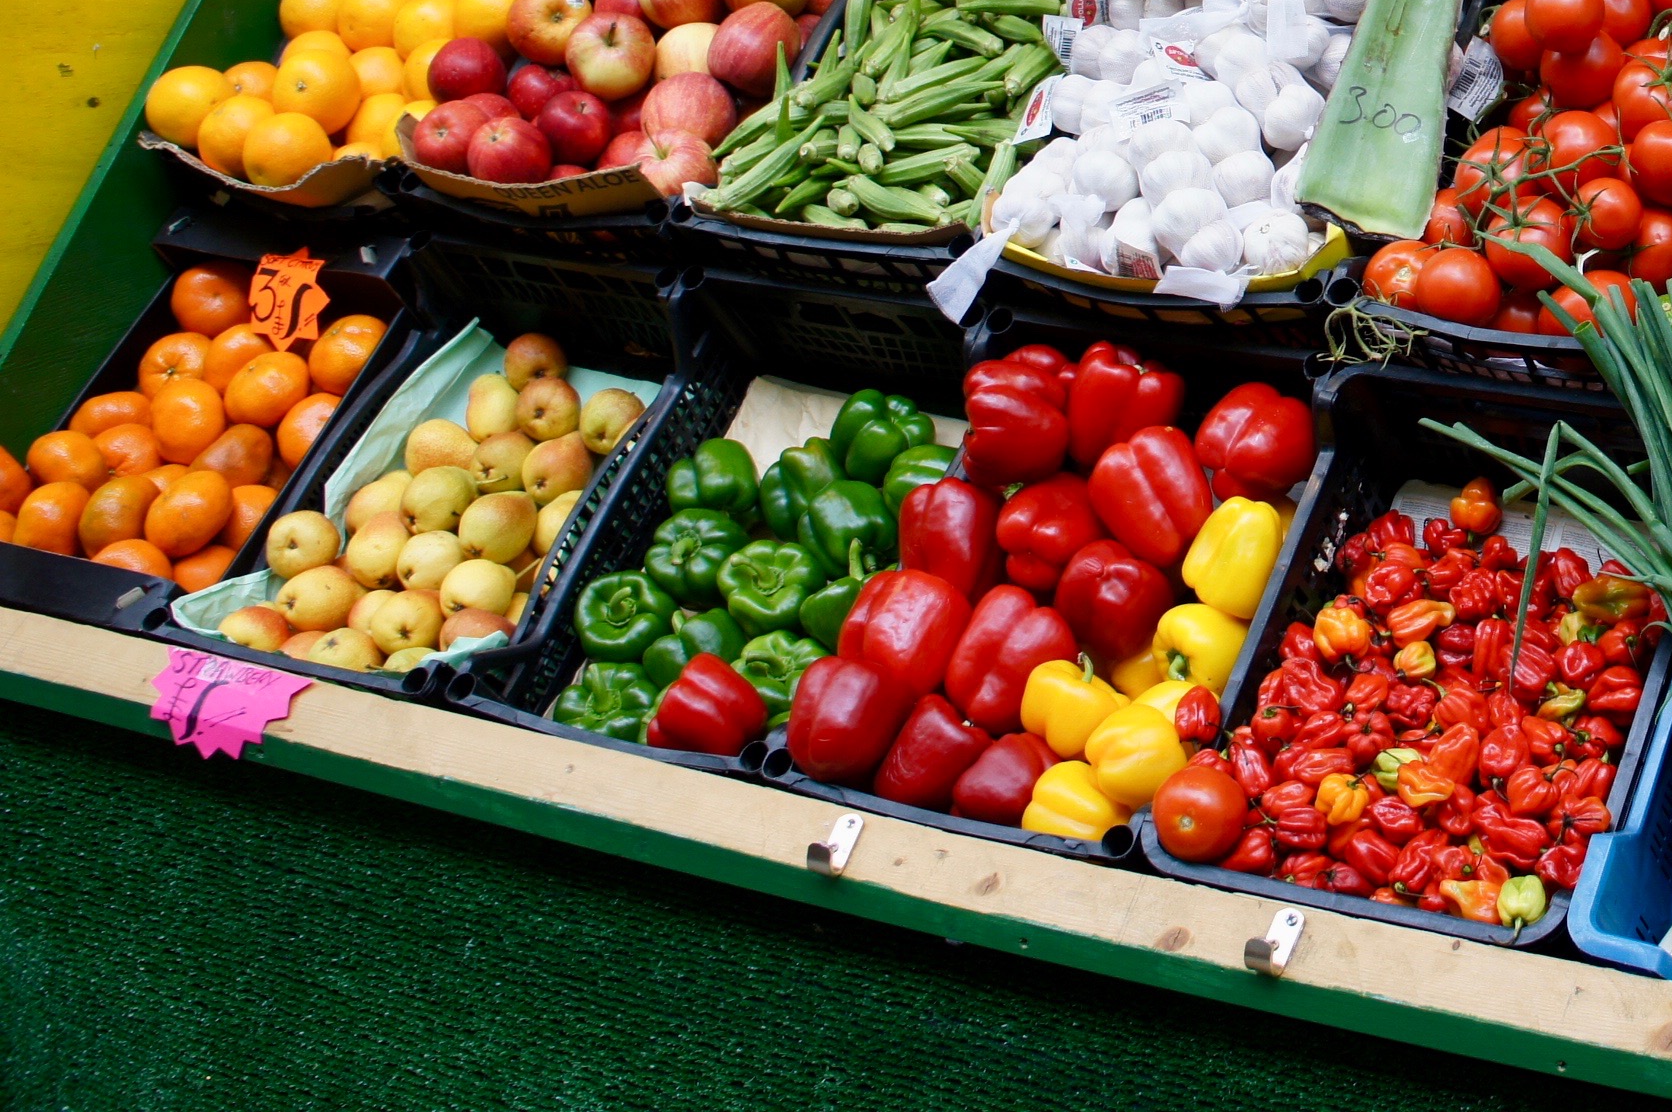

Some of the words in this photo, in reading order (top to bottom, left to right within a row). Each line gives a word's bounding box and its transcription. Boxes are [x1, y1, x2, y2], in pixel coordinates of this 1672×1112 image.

[1338, 85, 1422, 136] 3.00
[492, 181, 574, 201] QUEEN
[574, 169, 641, 193] ALOE
[250, 267, 281, 323] 3
